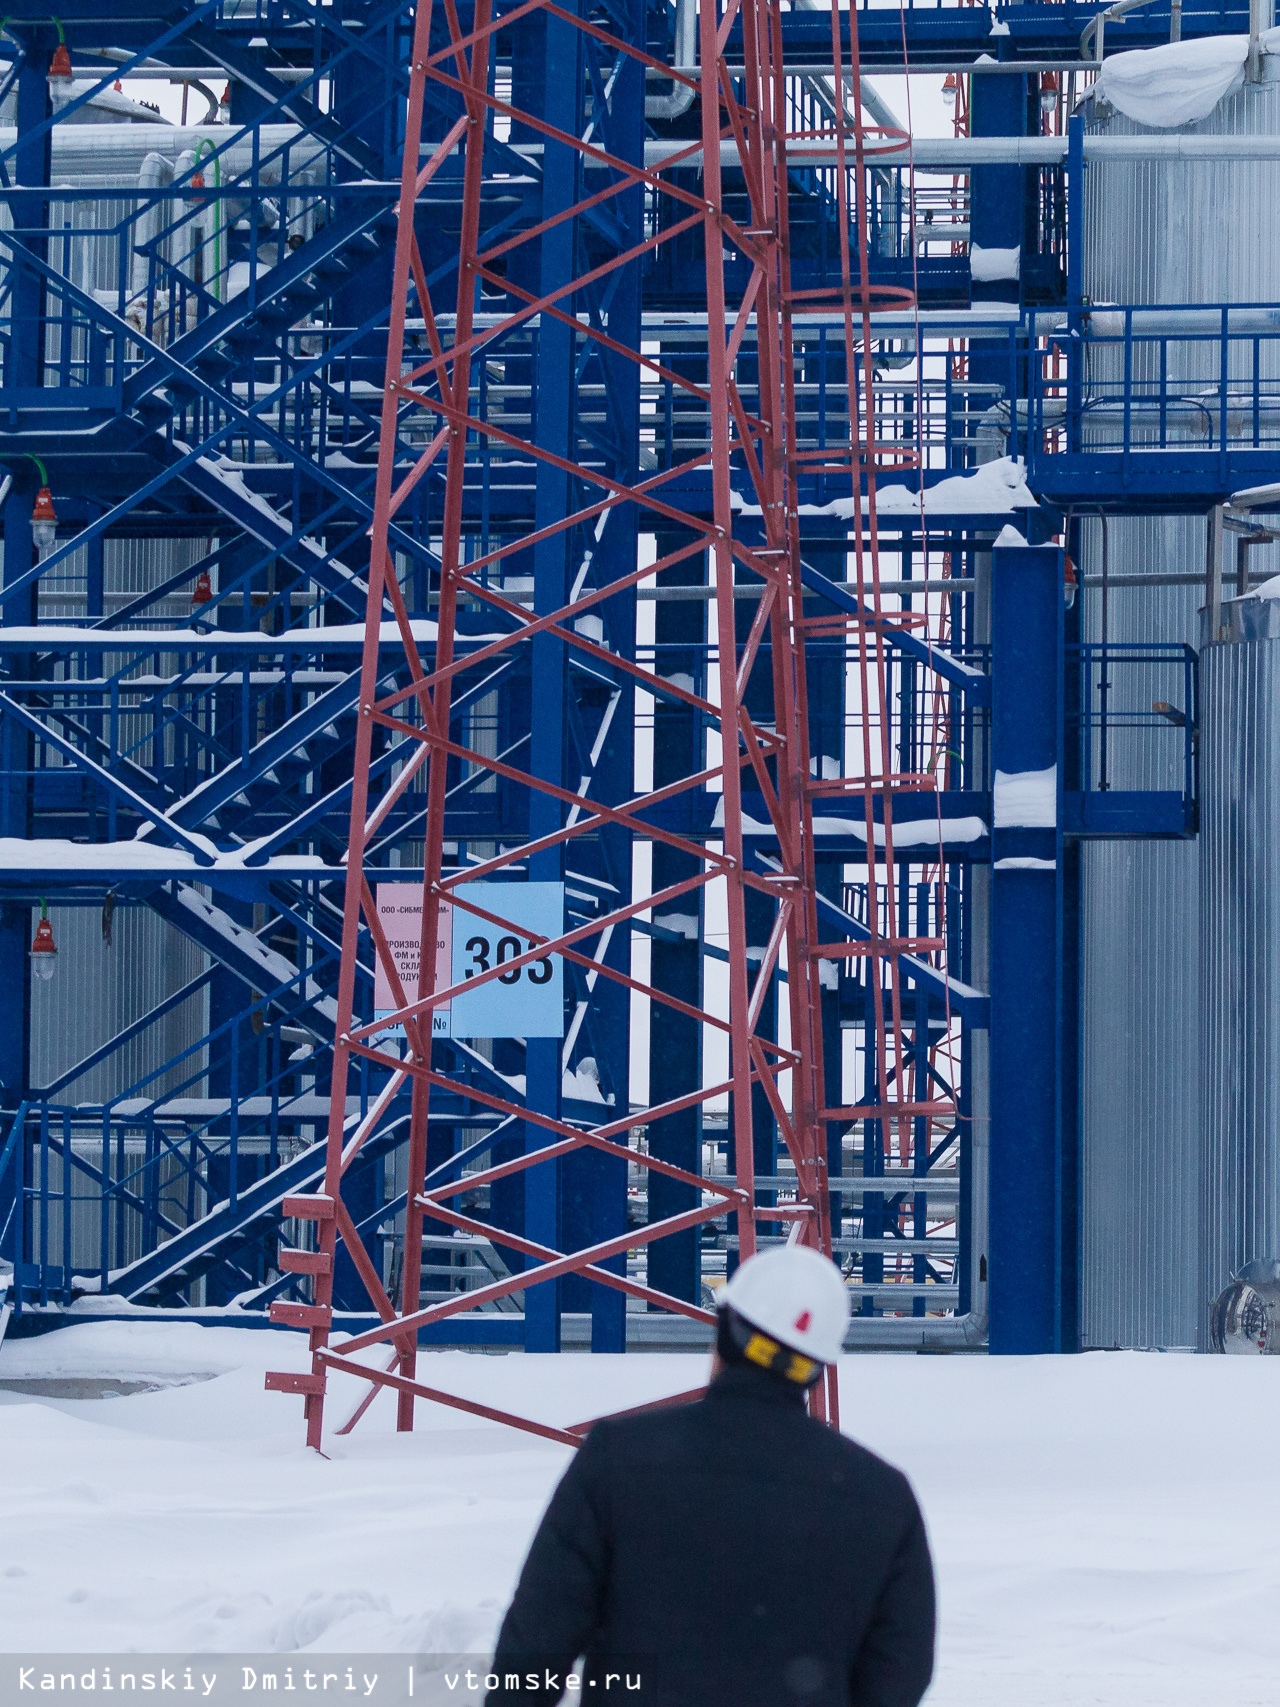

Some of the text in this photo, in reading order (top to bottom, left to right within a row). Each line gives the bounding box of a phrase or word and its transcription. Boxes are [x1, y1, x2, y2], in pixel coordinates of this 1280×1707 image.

[381, 906, 396, 914] ООО
[394, 951, 409, 960] ФМ
[465, 936, 553, 985] 303
